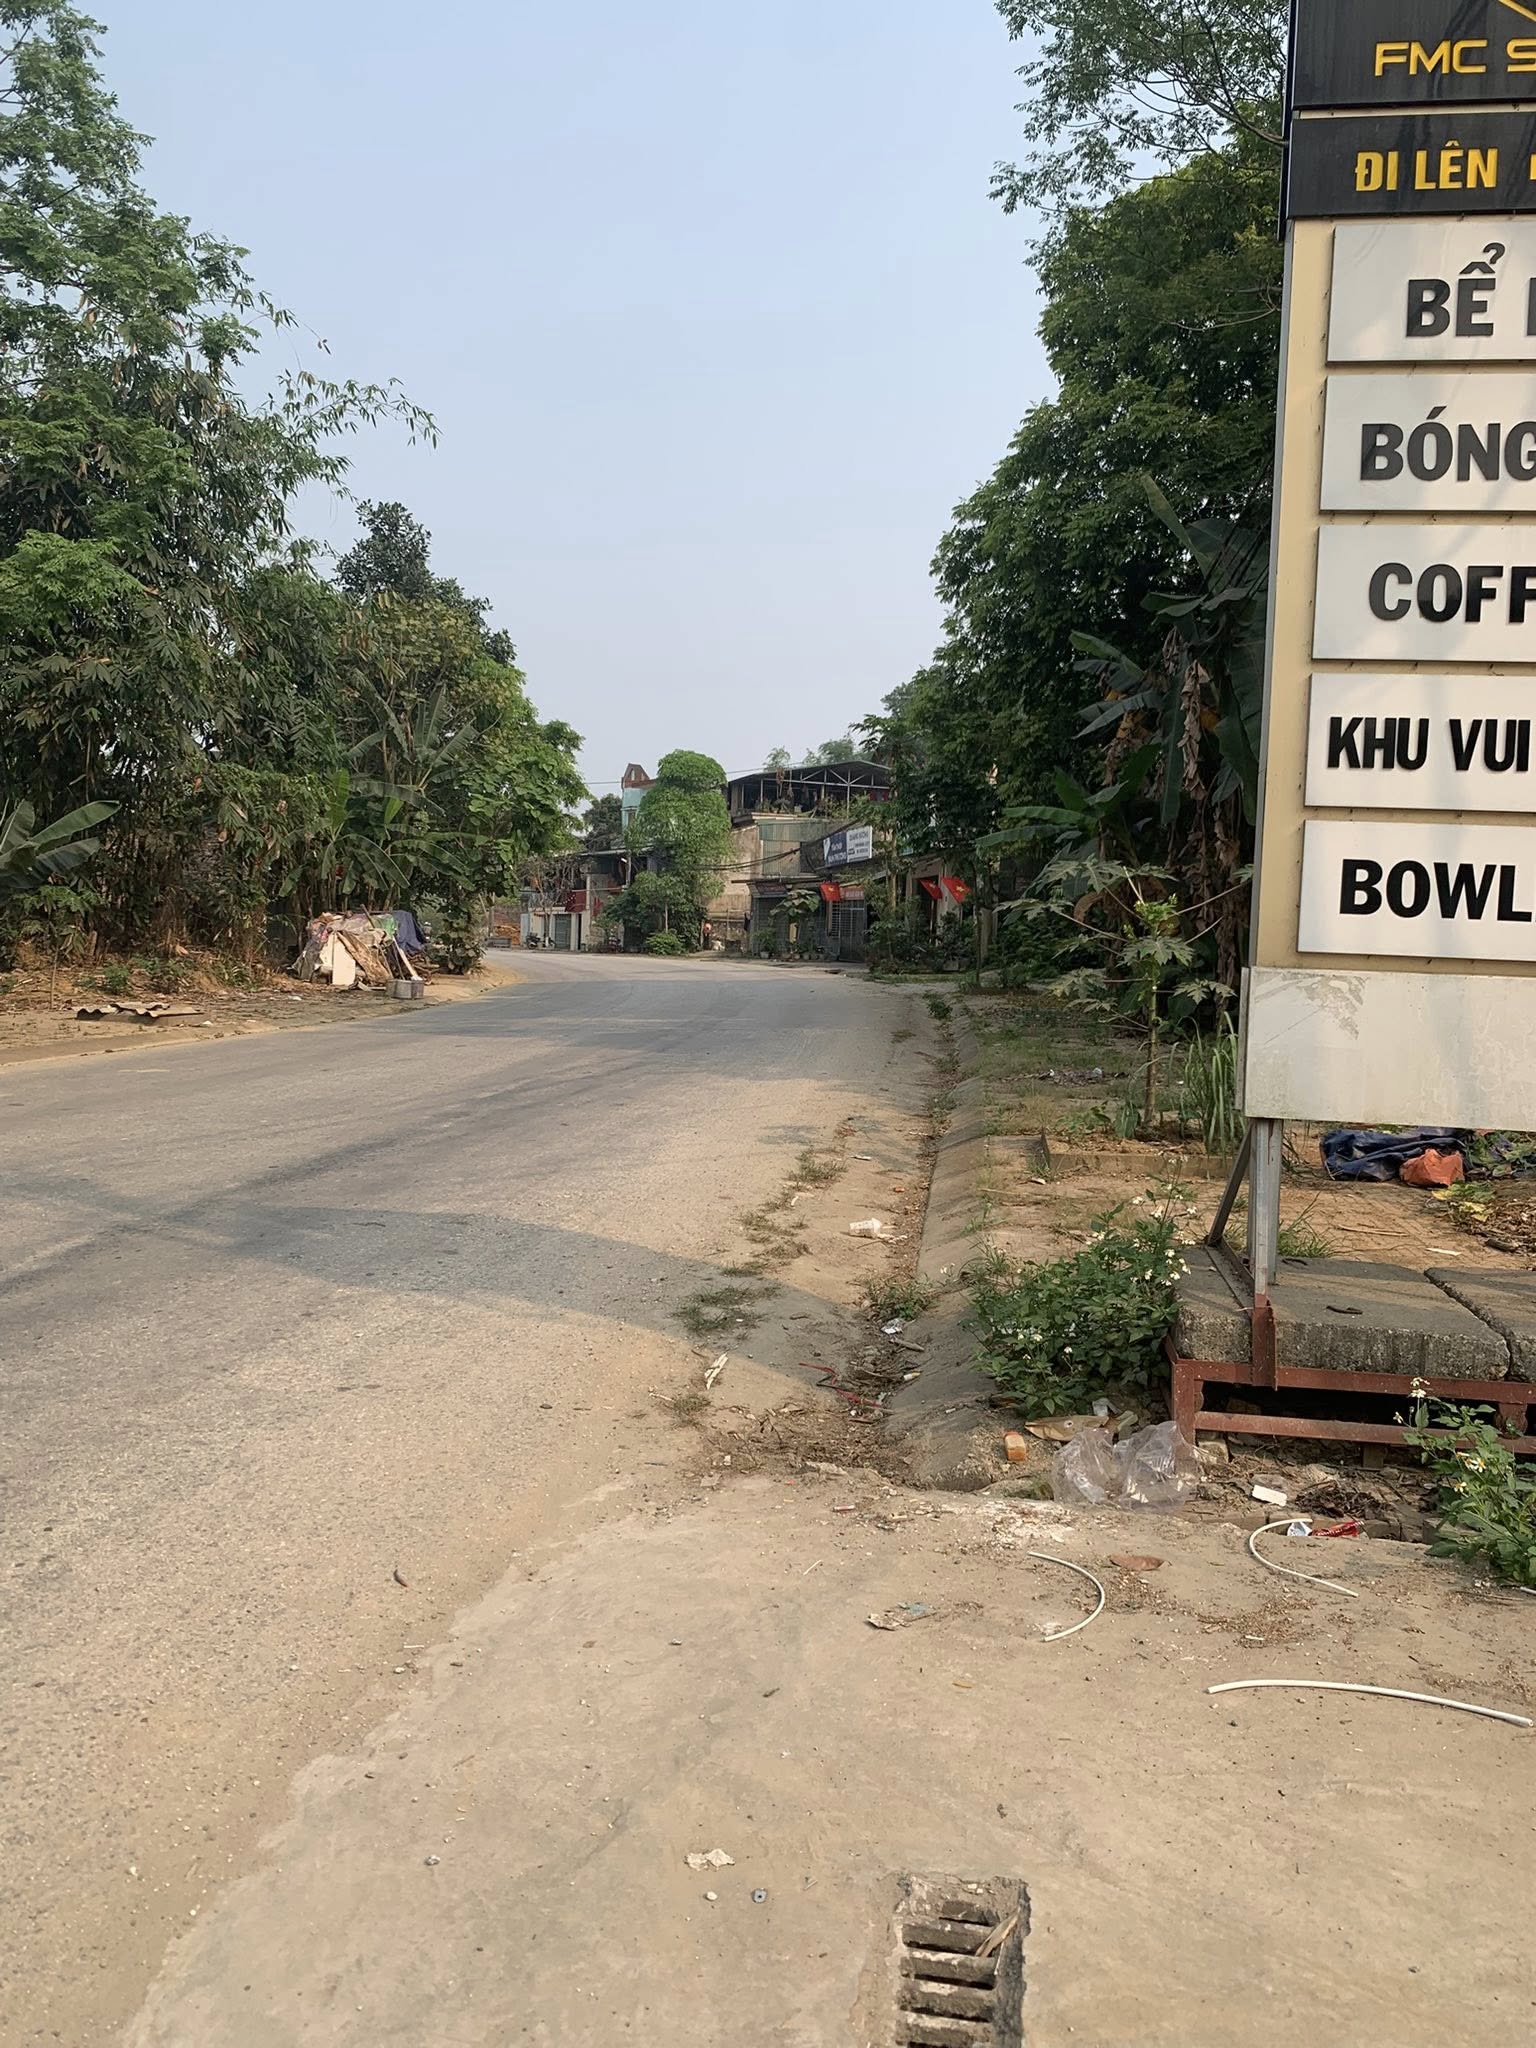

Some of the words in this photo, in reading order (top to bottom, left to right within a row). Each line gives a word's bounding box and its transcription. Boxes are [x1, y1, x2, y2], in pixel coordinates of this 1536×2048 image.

[1374, 39, 1488, 77] FMC
[1355, 151, 1399, 192] ĐI
[1414, 139, 1498, 190] LÊN
[1405, 241, 1506, 338] BỂ
[1360, 405, 1536, 482] BÓNG
[1369, 562, 1536, 623] COFF
[1327, 716, 1430, 771] KHU
[1449, 718, 1531, 773] VUI
[1339, 858, 1536, 923] BOWL
